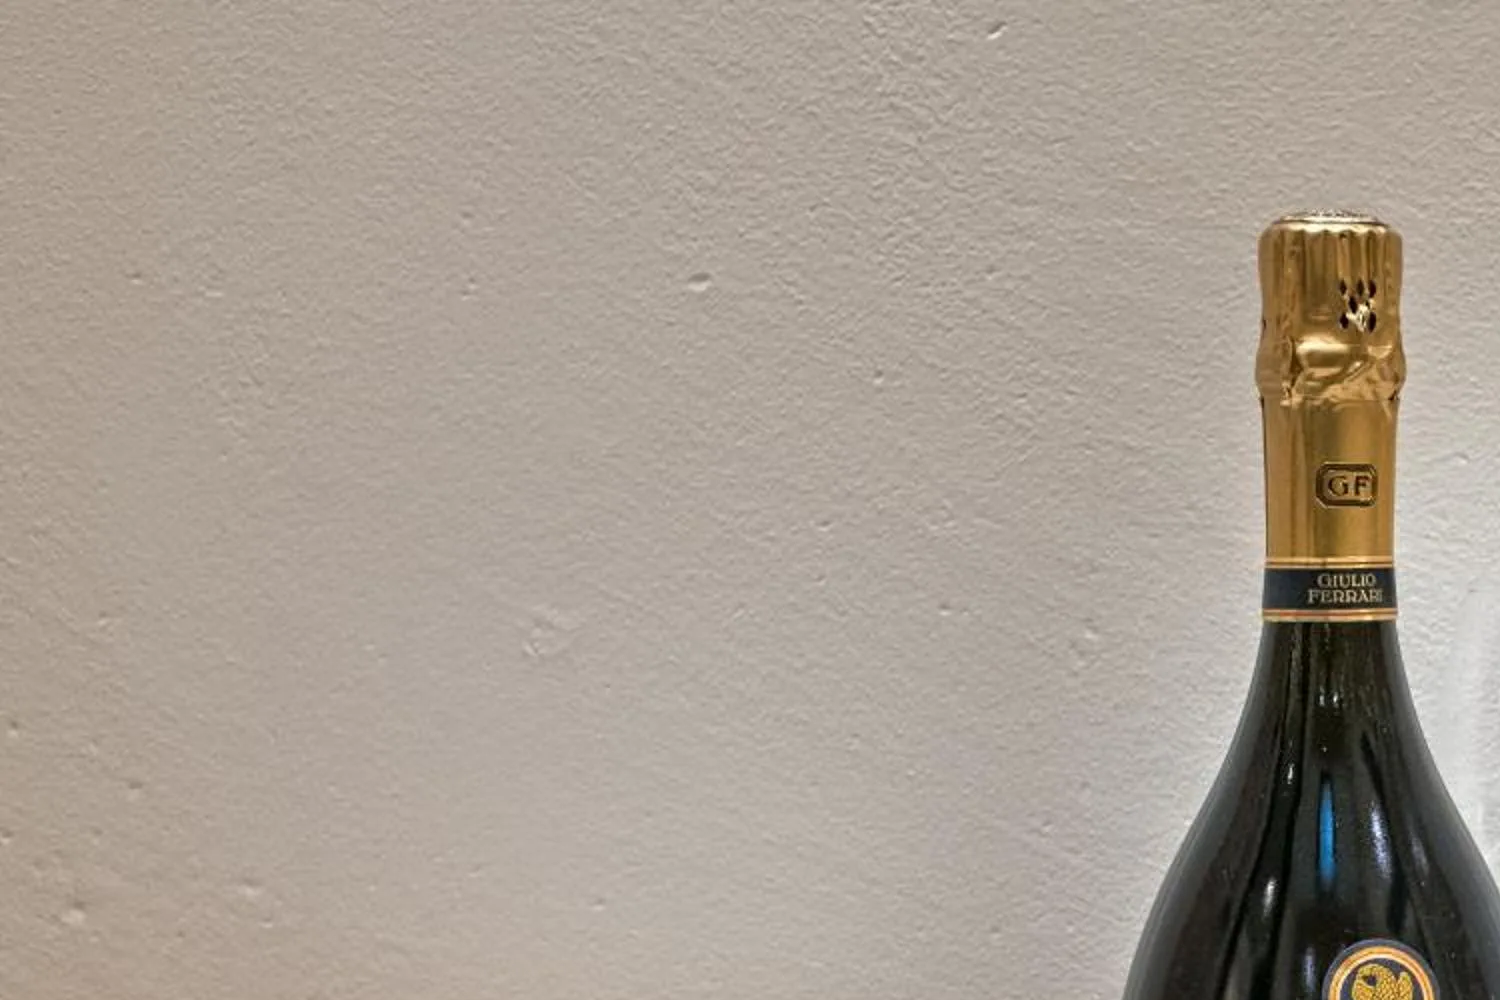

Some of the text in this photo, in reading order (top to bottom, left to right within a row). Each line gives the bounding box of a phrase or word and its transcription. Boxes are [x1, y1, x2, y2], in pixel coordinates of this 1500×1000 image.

[1327, 475, 1371, 496] GF
[1316, 572, 1377, 589] GIULIO
[1307, 588, 1383, 604] FERRARI
